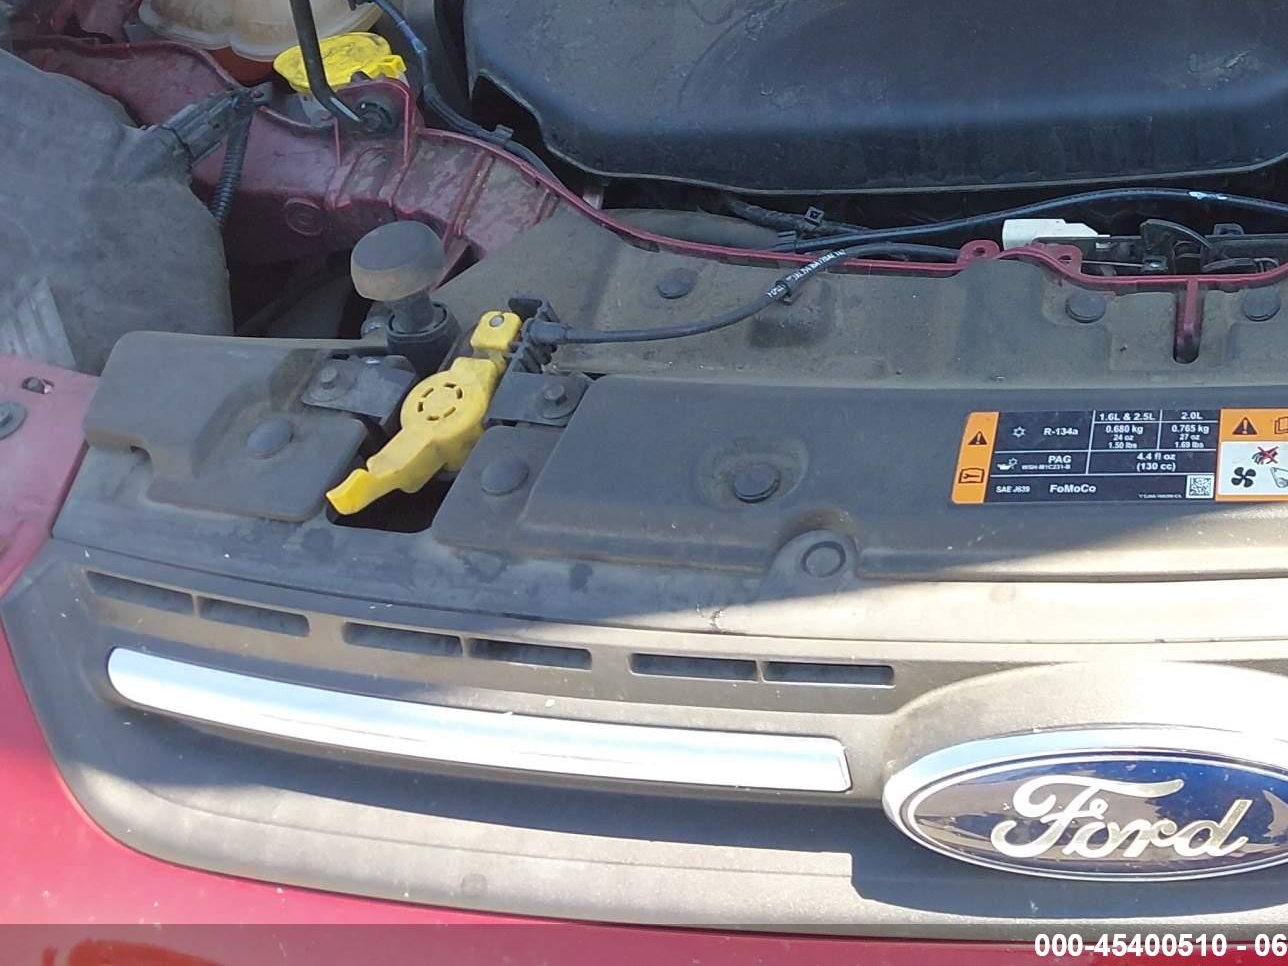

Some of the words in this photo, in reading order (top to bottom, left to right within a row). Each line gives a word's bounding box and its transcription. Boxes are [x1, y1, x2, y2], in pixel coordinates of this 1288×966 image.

[1099, 412, 1121, 421] 1.6L
[1122, 412, 1131, 421] &
[1133, 412, 1156, 421] 2.5L
[1180, 411, 1204, 420] 2.0L
[1043, 427, 1079, 436] R-134a
[1105, 424, 1130, 433] 0.680
[1131, 424, 1144, 434] kg
[1171, 424, 1196, 433] 0.765
[1197, 424, 1210, 435] kg
[1125, 441, 1138, 449] lbs
[1048, 455, 1072, 464] PAG
[1136, 453, 1153, 461] 4.4
[1154, 453, 1162, 461] fl
[1136, 462, 1158, 472] (130
[1160, 462, 1176, 472] cc)
[996, 485, 1012, 493] SAE
[1049, 483, 1097, 494] FoMoCo
[991, 774, 1253, 858] Ford
